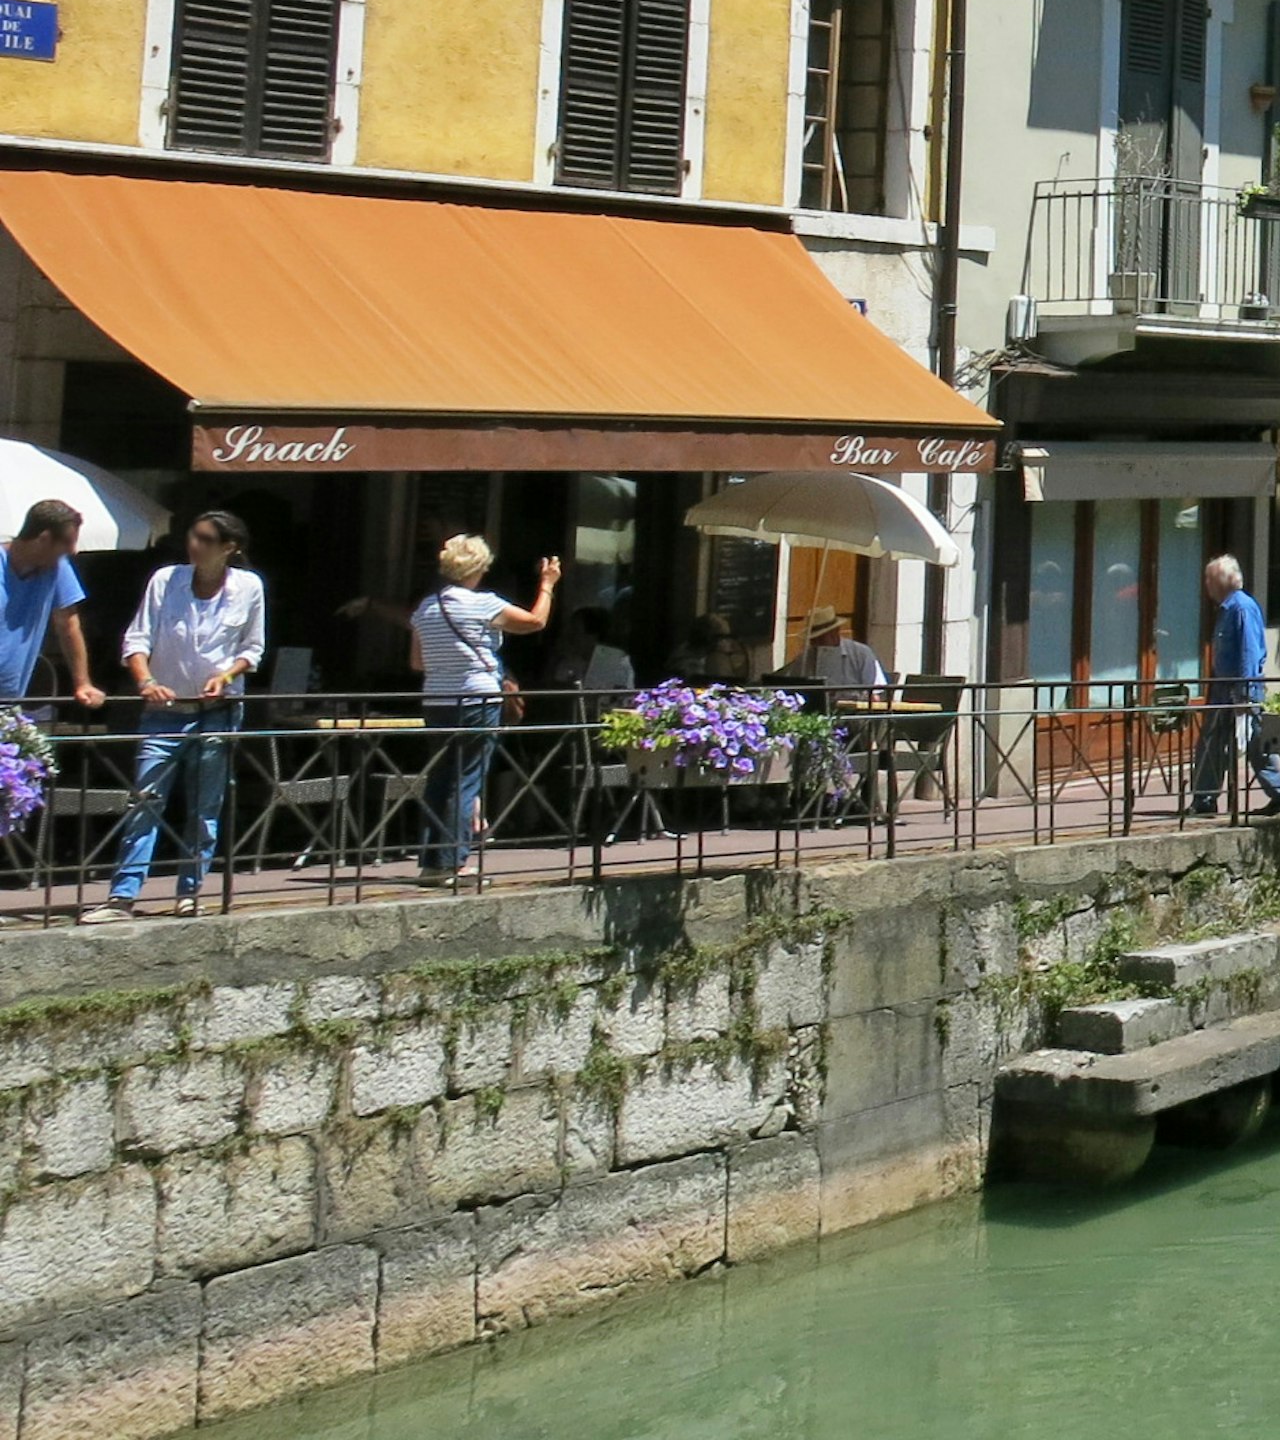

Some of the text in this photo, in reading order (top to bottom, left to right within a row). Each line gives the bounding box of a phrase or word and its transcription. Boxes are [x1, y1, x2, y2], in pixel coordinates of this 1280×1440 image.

[0, 3, 32, 19] UAI
[3, 20, 21, 32] DE
[212, 425, 356, 462] Snack
[829, 435, 987, 471] Bar Café
